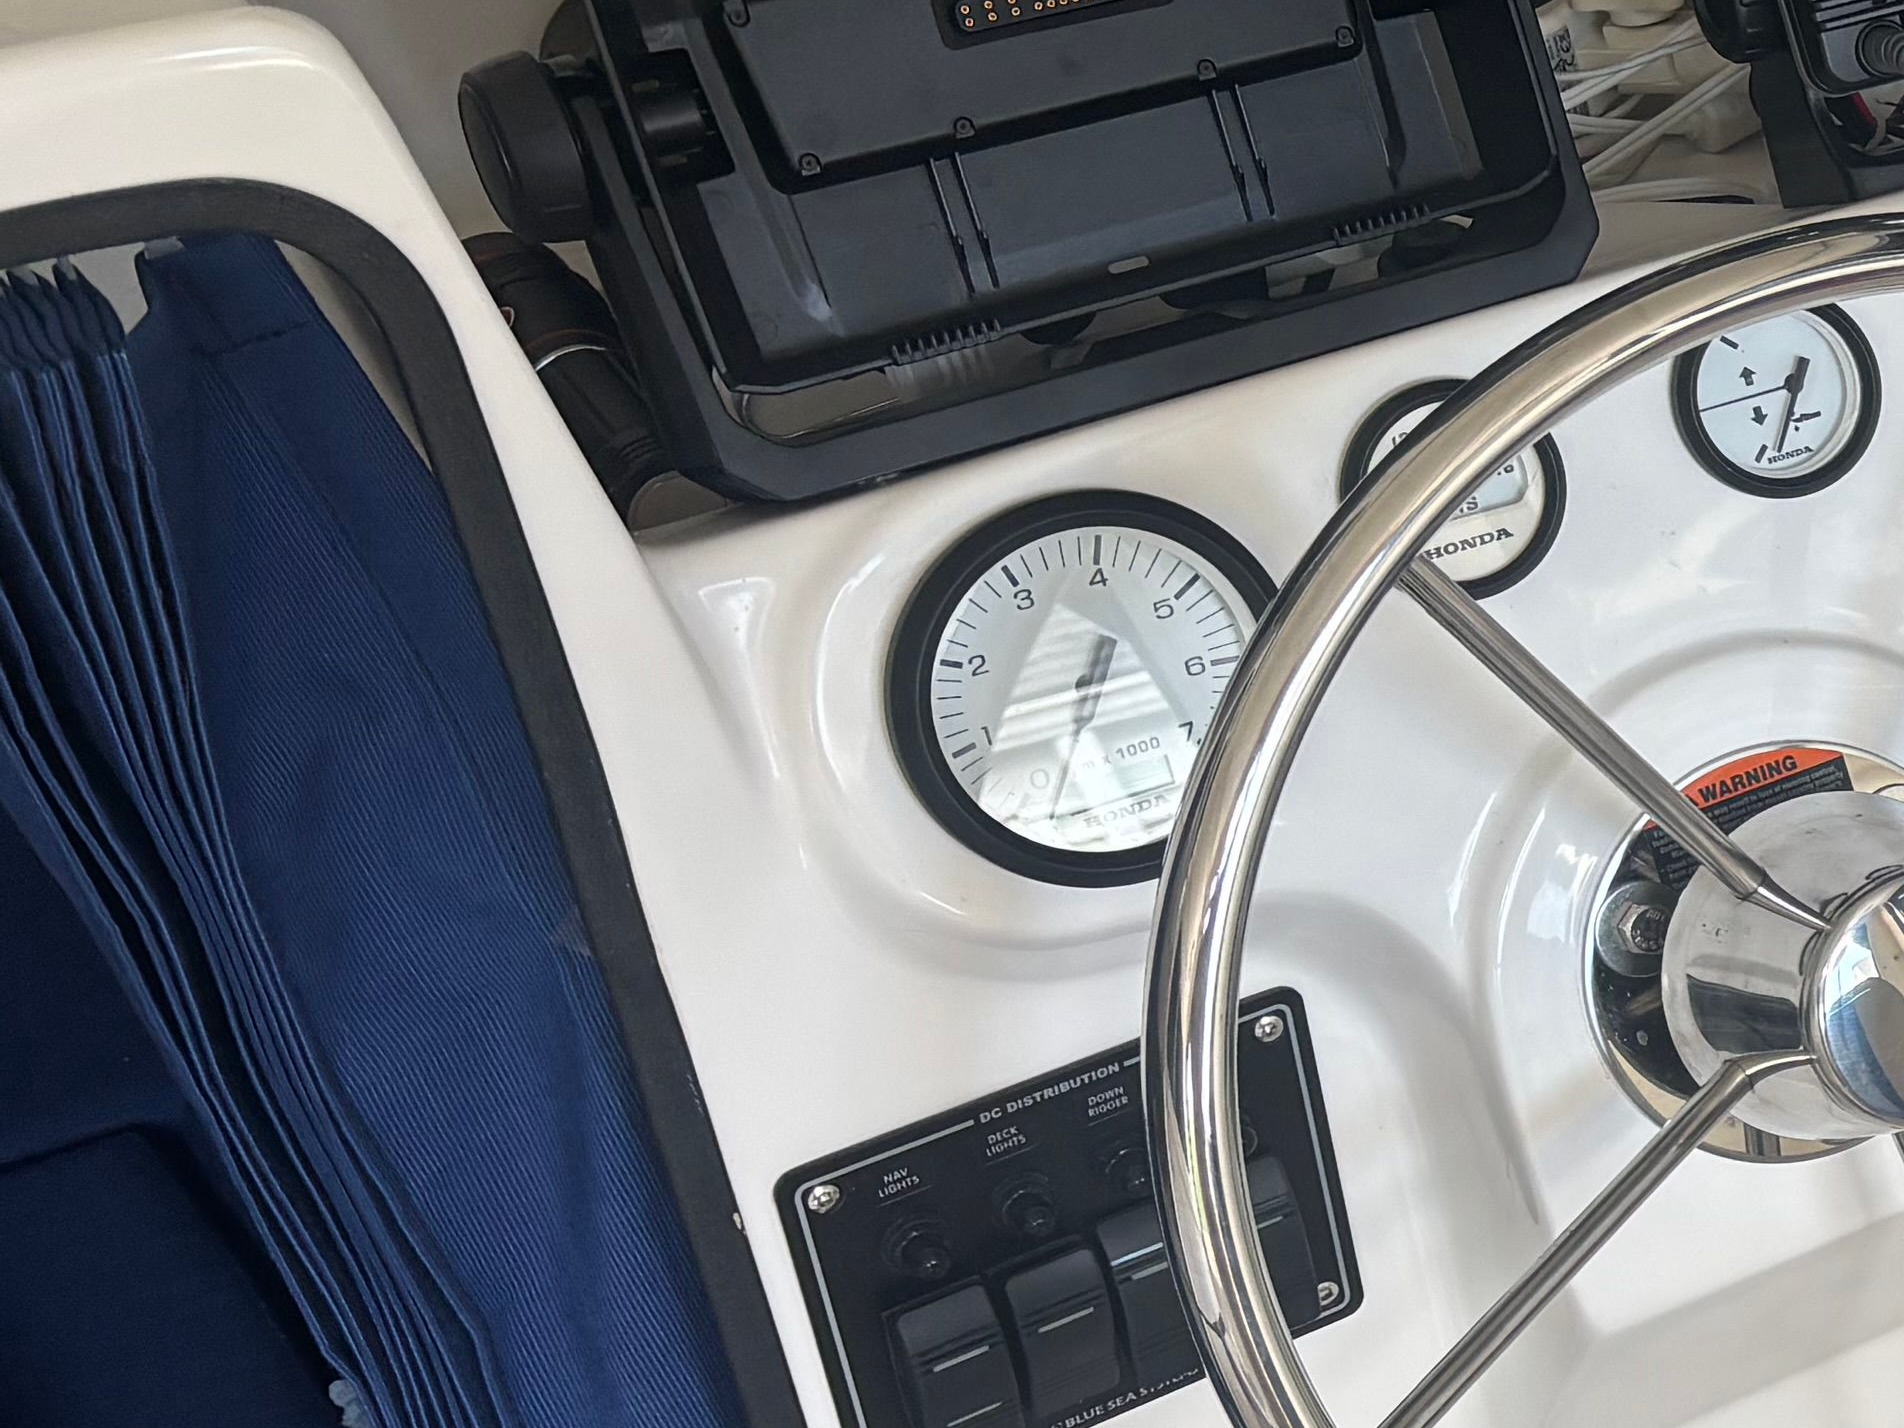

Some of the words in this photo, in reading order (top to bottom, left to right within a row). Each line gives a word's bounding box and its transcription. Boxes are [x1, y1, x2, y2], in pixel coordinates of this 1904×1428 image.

[1768, 446, 1814, 464] HONDA
[1424, 527, 1514, 560] HONDA
[1089, 567, 1108, 588] 4
[1013, 589, 1034, 610] 3
[1153, 599, 1174, 619] 5
[968, 655, 989, 677] 2
[1184, 656, 1206, 676] 6
[981, 727, 993, 746] 1
[1178, 721, 1194, 742] 7
[1115, 737, 1160, 760] 1000
[1697, 755, 1797, 805] WARNING
[1084, 794, 1171, 828] HONDA
[979, 1107, 1002, 1123] DC
[1006, 1062, 1120, 1114] DISTRIBUTION
[1087, 1086, 1125, 1106] DOWN
[1088, 1095, 1129, 1117] RIGGER
[986, 1134, 1027, 1157] LIGHTS
[987, 1126, 1019, 1145] DECK
[878, 1175, 920, 1198] LIGHTS
[883, 1167, 909, 1185] NAV
[1065, 1404, 1105, 1428] BLUE
[1107, 1392, 1137, 1411] SEA
